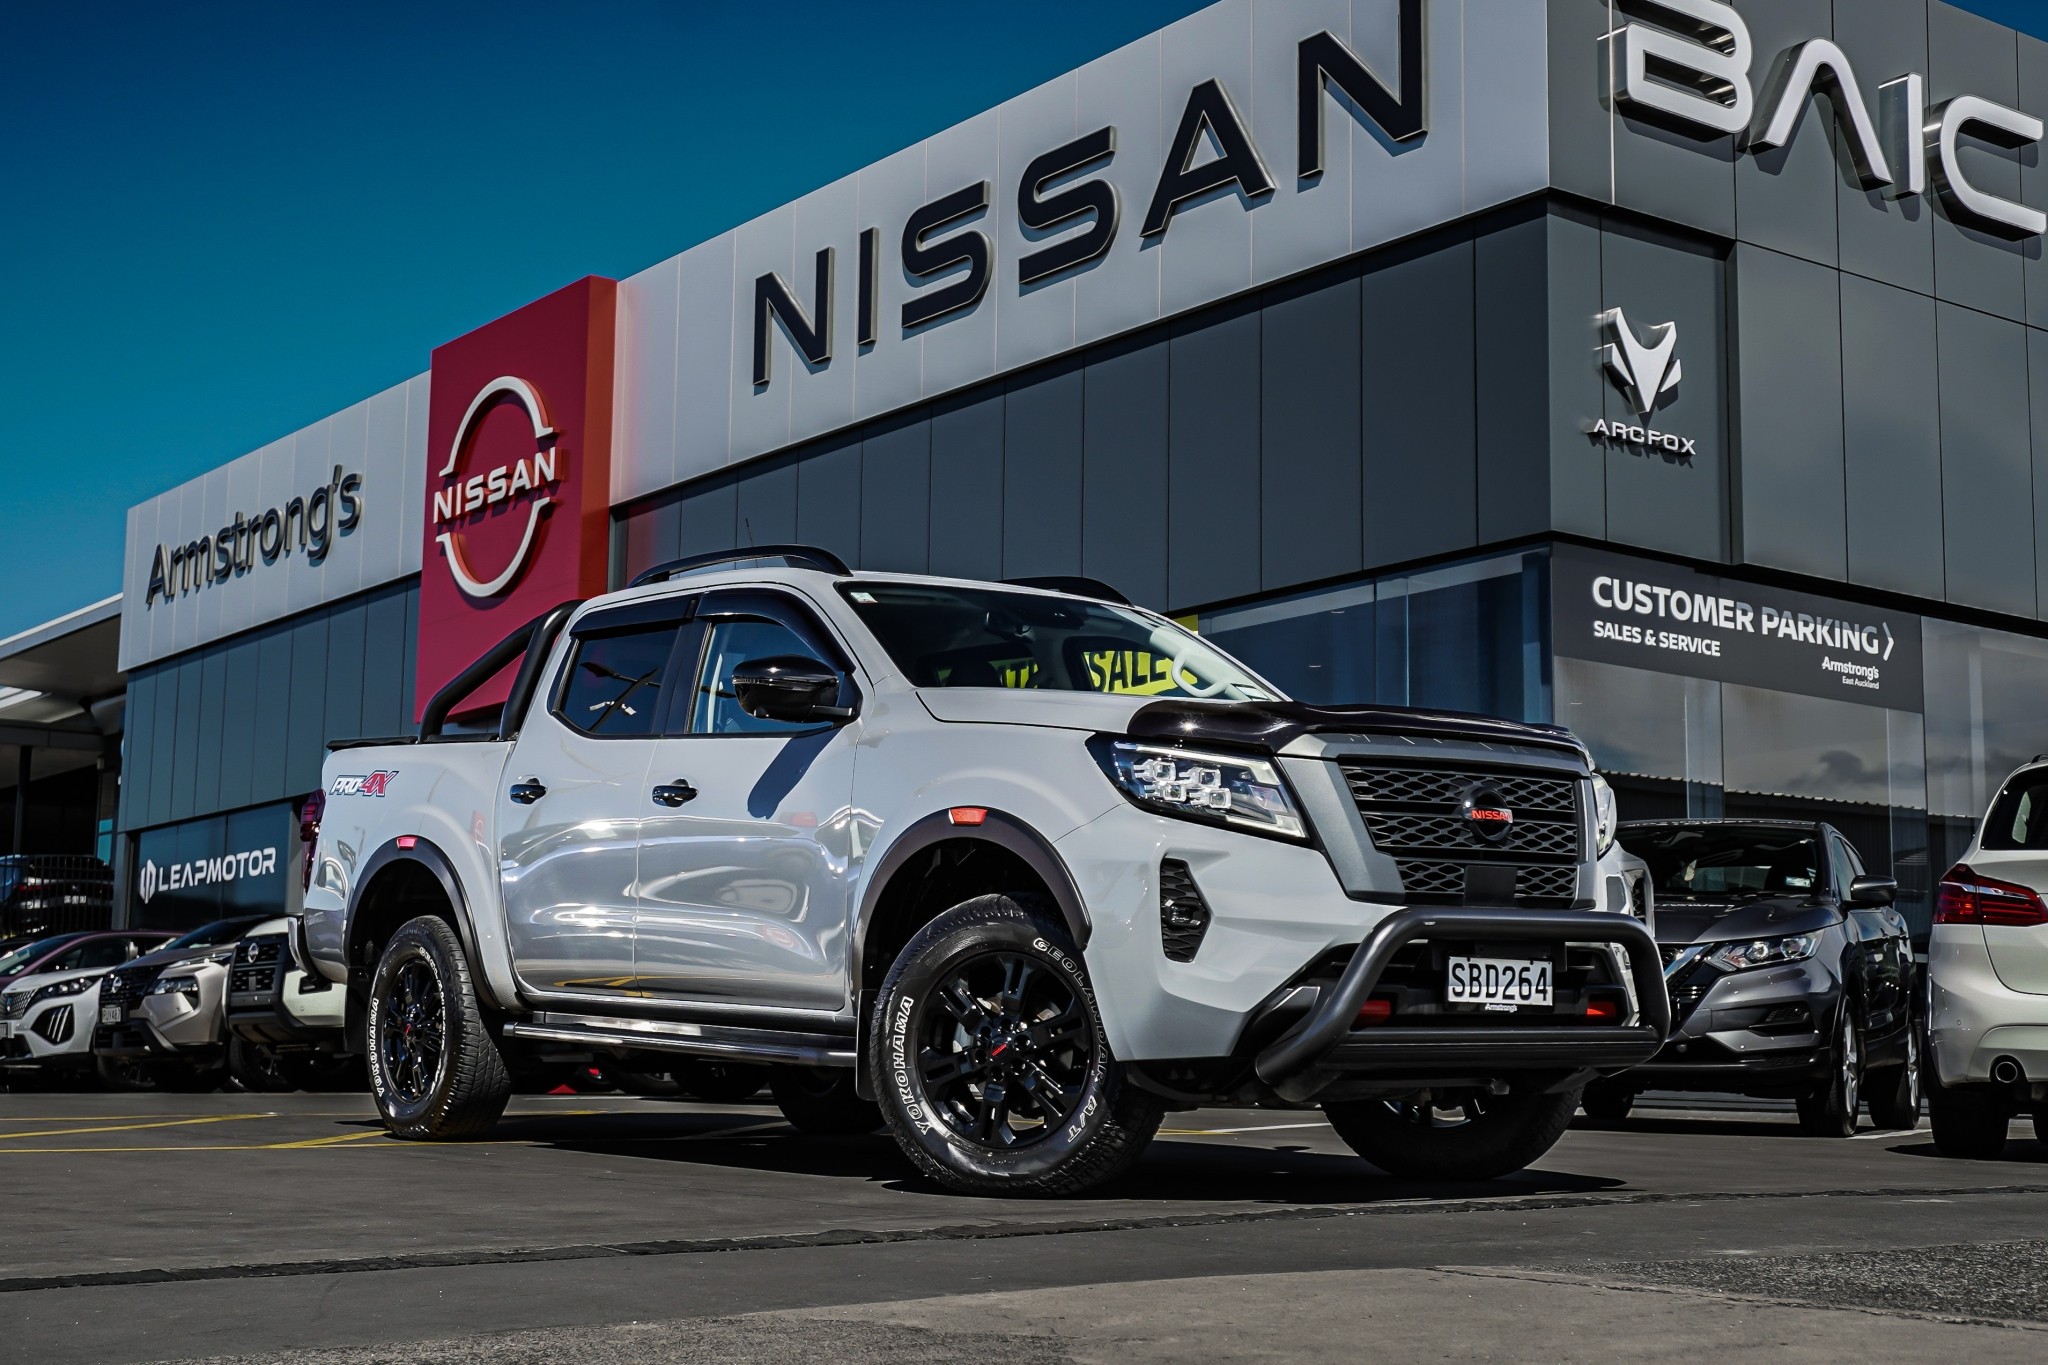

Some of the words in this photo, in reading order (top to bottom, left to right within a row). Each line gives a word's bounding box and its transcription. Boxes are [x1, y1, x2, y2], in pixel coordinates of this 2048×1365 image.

[1624, 0, 2047, 235] BAIC
[754, 0, 1428, 386] NISSAN
[1593, 418, 1697, 455] ARCFOX
[432, 447, 556, 523] NISSAN
[145, 464, 362, 605] Armstrong's
[1592, 576, 1755, 633] CUSTOMER
[1761, 606, 1880, 655] PARKING
[1593, 620, 1642, 644] SALES
[1645, 628, 1657, 647] &
[1659, 630, 1721, 657] SERVICE
[1821, 656, 1880, 680] Armstrong's
[1842, 676, 1854, 686] East
[1854, 678, 1880, 690] Auckland
[1471, 809, 1511, 821] NISSAN
[158, 846, 277, 892] LEAPMOTOR
[1451, 962, 1548, 1002] SBD264
[892, 995, 931, 1136] YOKOHAMA
[1068, 1095, 1098, 1144] A/T
